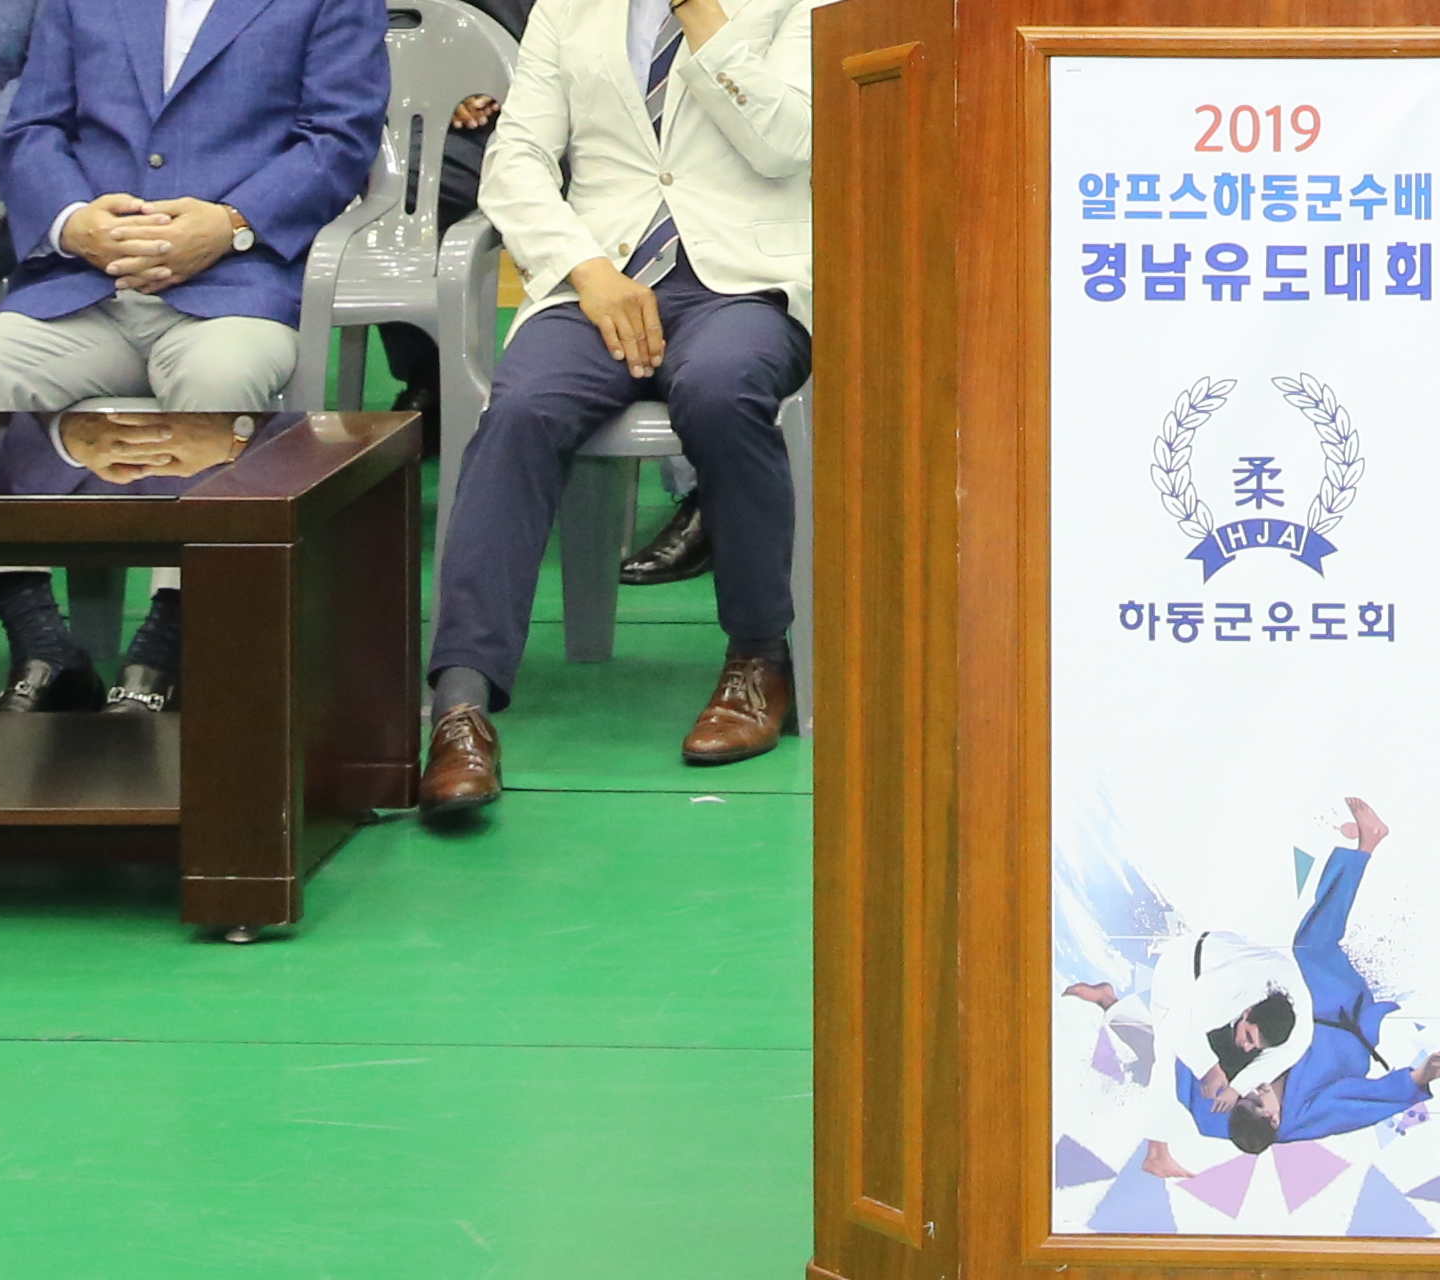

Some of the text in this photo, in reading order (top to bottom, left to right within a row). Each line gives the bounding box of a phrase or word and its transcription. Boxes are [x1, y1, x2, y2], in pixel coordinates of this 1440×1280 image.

[1194, 104, 1322, 153] 2019
[1078, 172, 1433, 223] 알프스하동군수배
[1081, 241, 1433, 303] 경남유도대회
[1232, 456, 1285, 510] 柔
[1225, 520, 1298, 550] HJA
[1118, 600, 1396, 644] 하동군유도회
